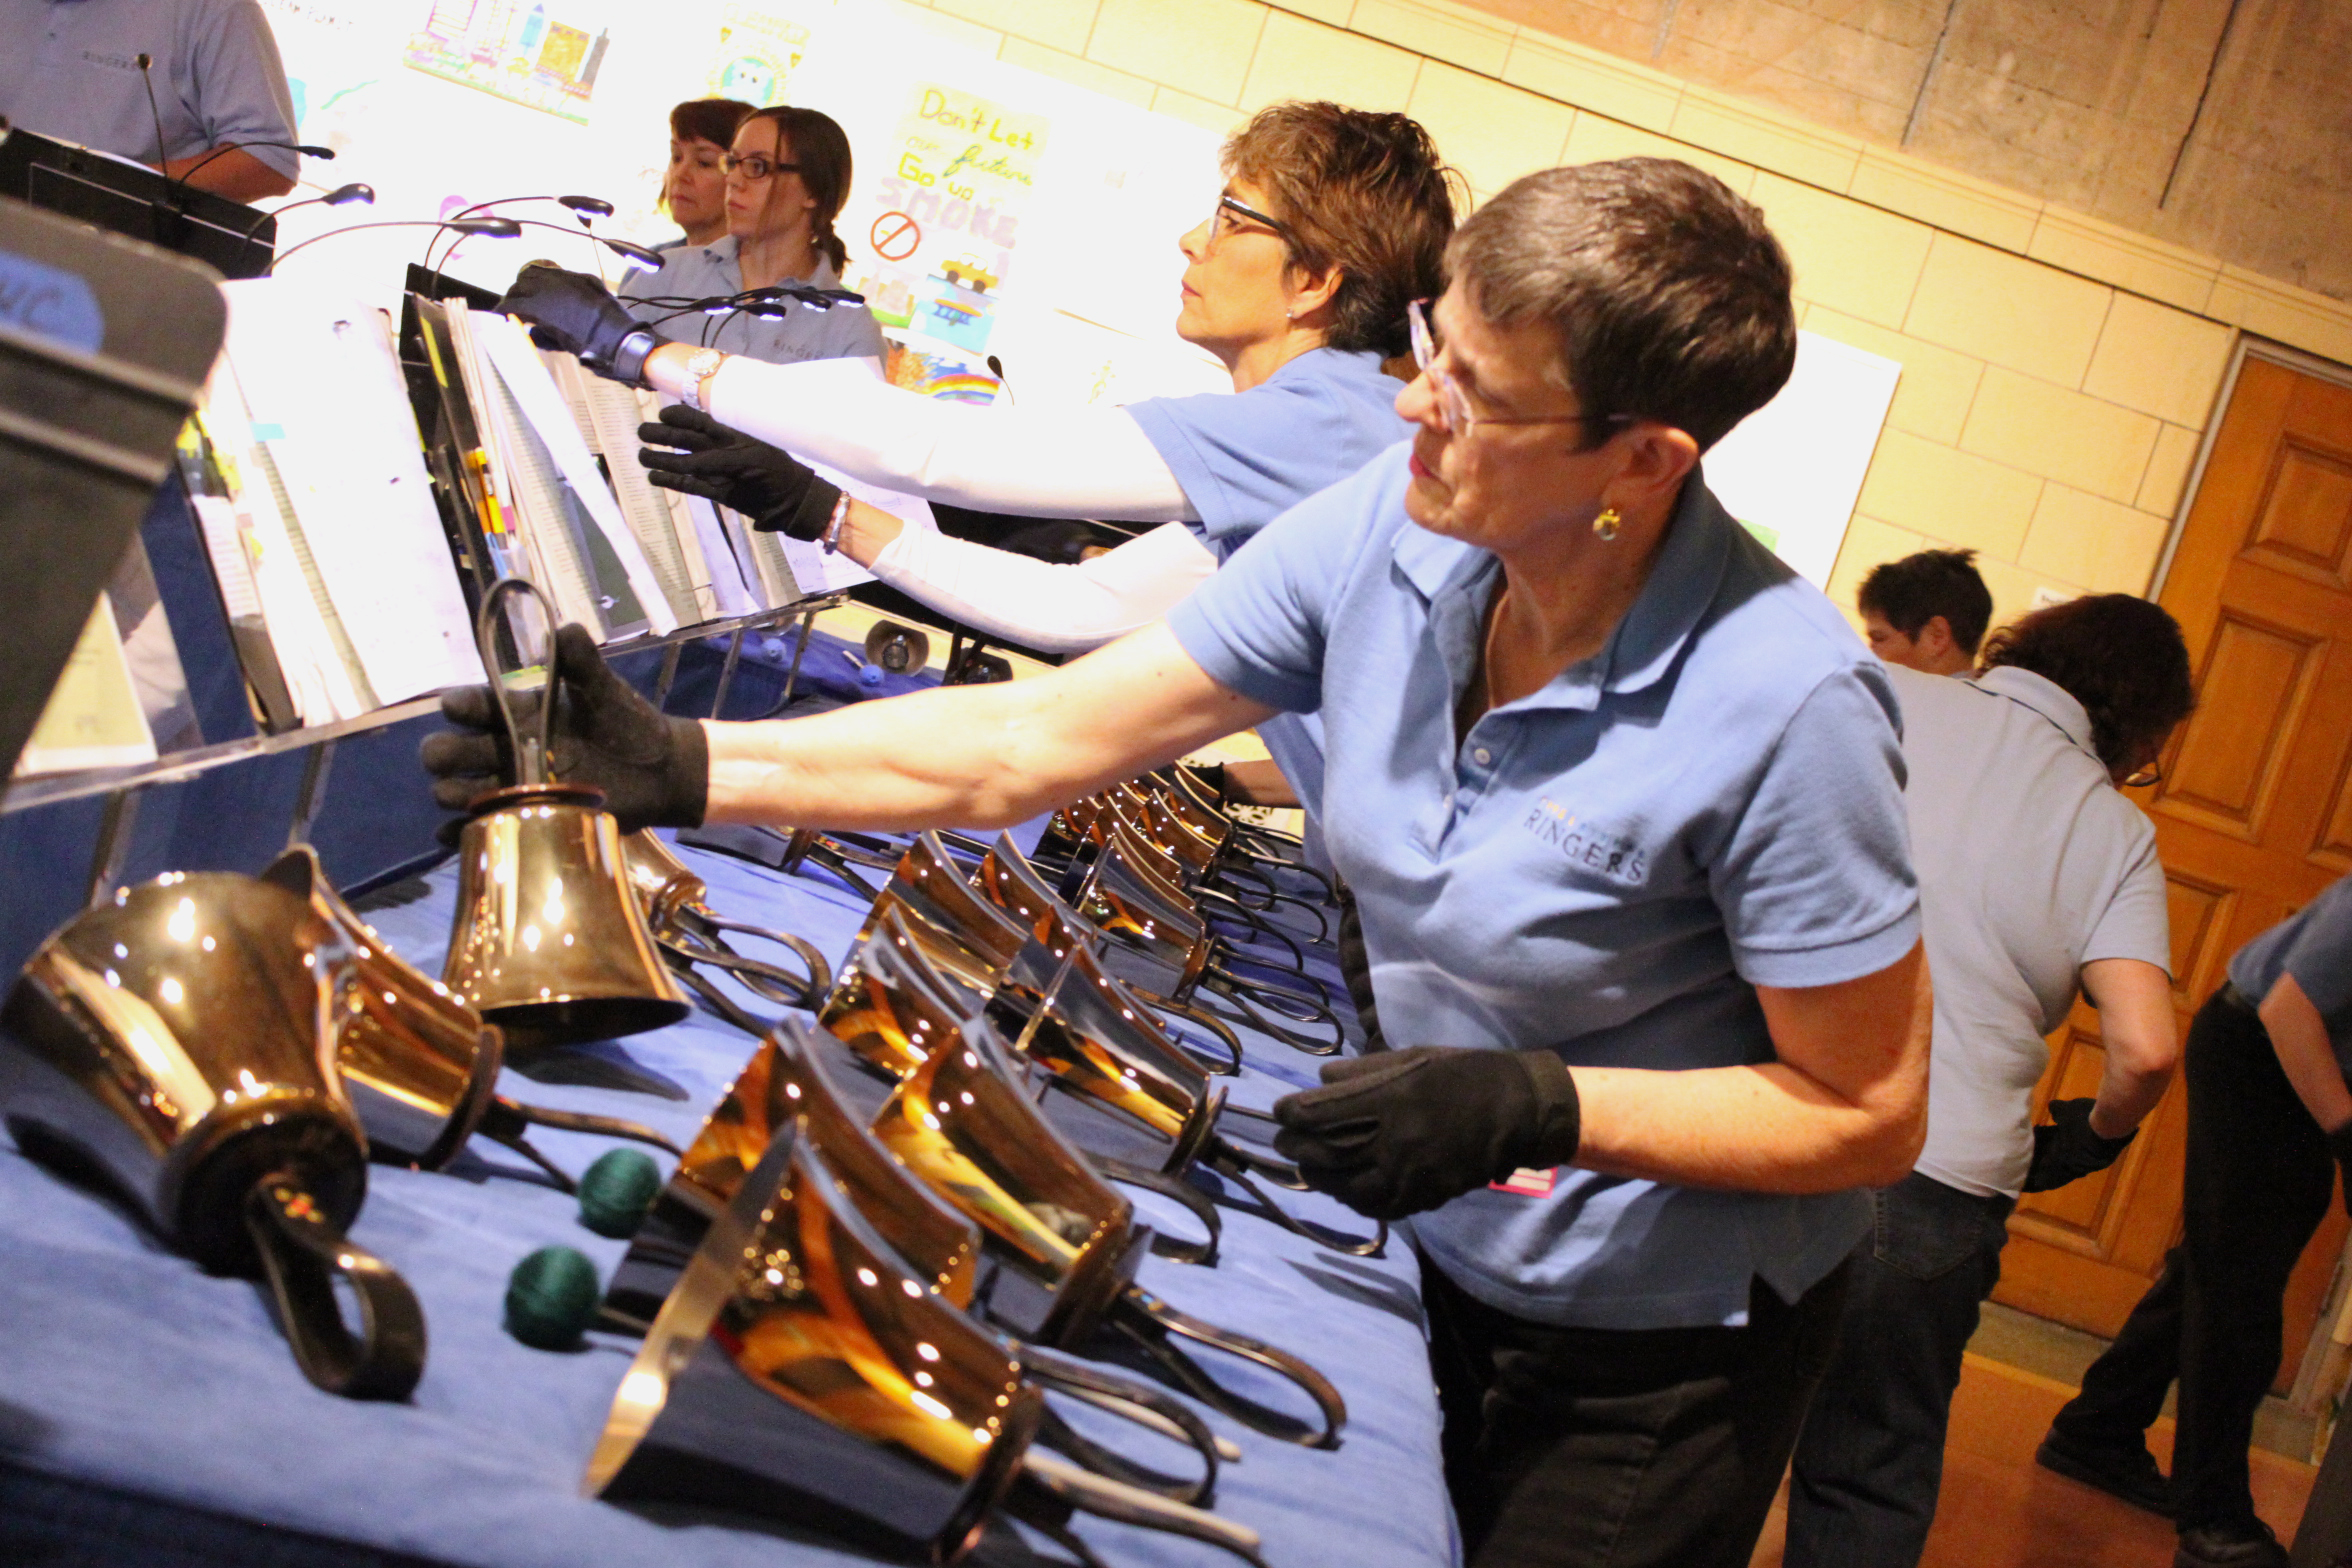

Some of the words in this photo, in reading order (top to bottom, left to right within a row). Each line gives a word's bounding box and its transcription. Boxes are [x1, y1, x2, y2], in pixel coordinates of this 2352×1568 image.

[920, 88, 986, 133] Don't
[988, 118, 1034, 150] Let
[897, 151, 937, 187] Go
[948, 181, 975, 201] up
[875, 177, 1019, 249] SMOKE
[1523, 807, 1646, 882] RINGERS
